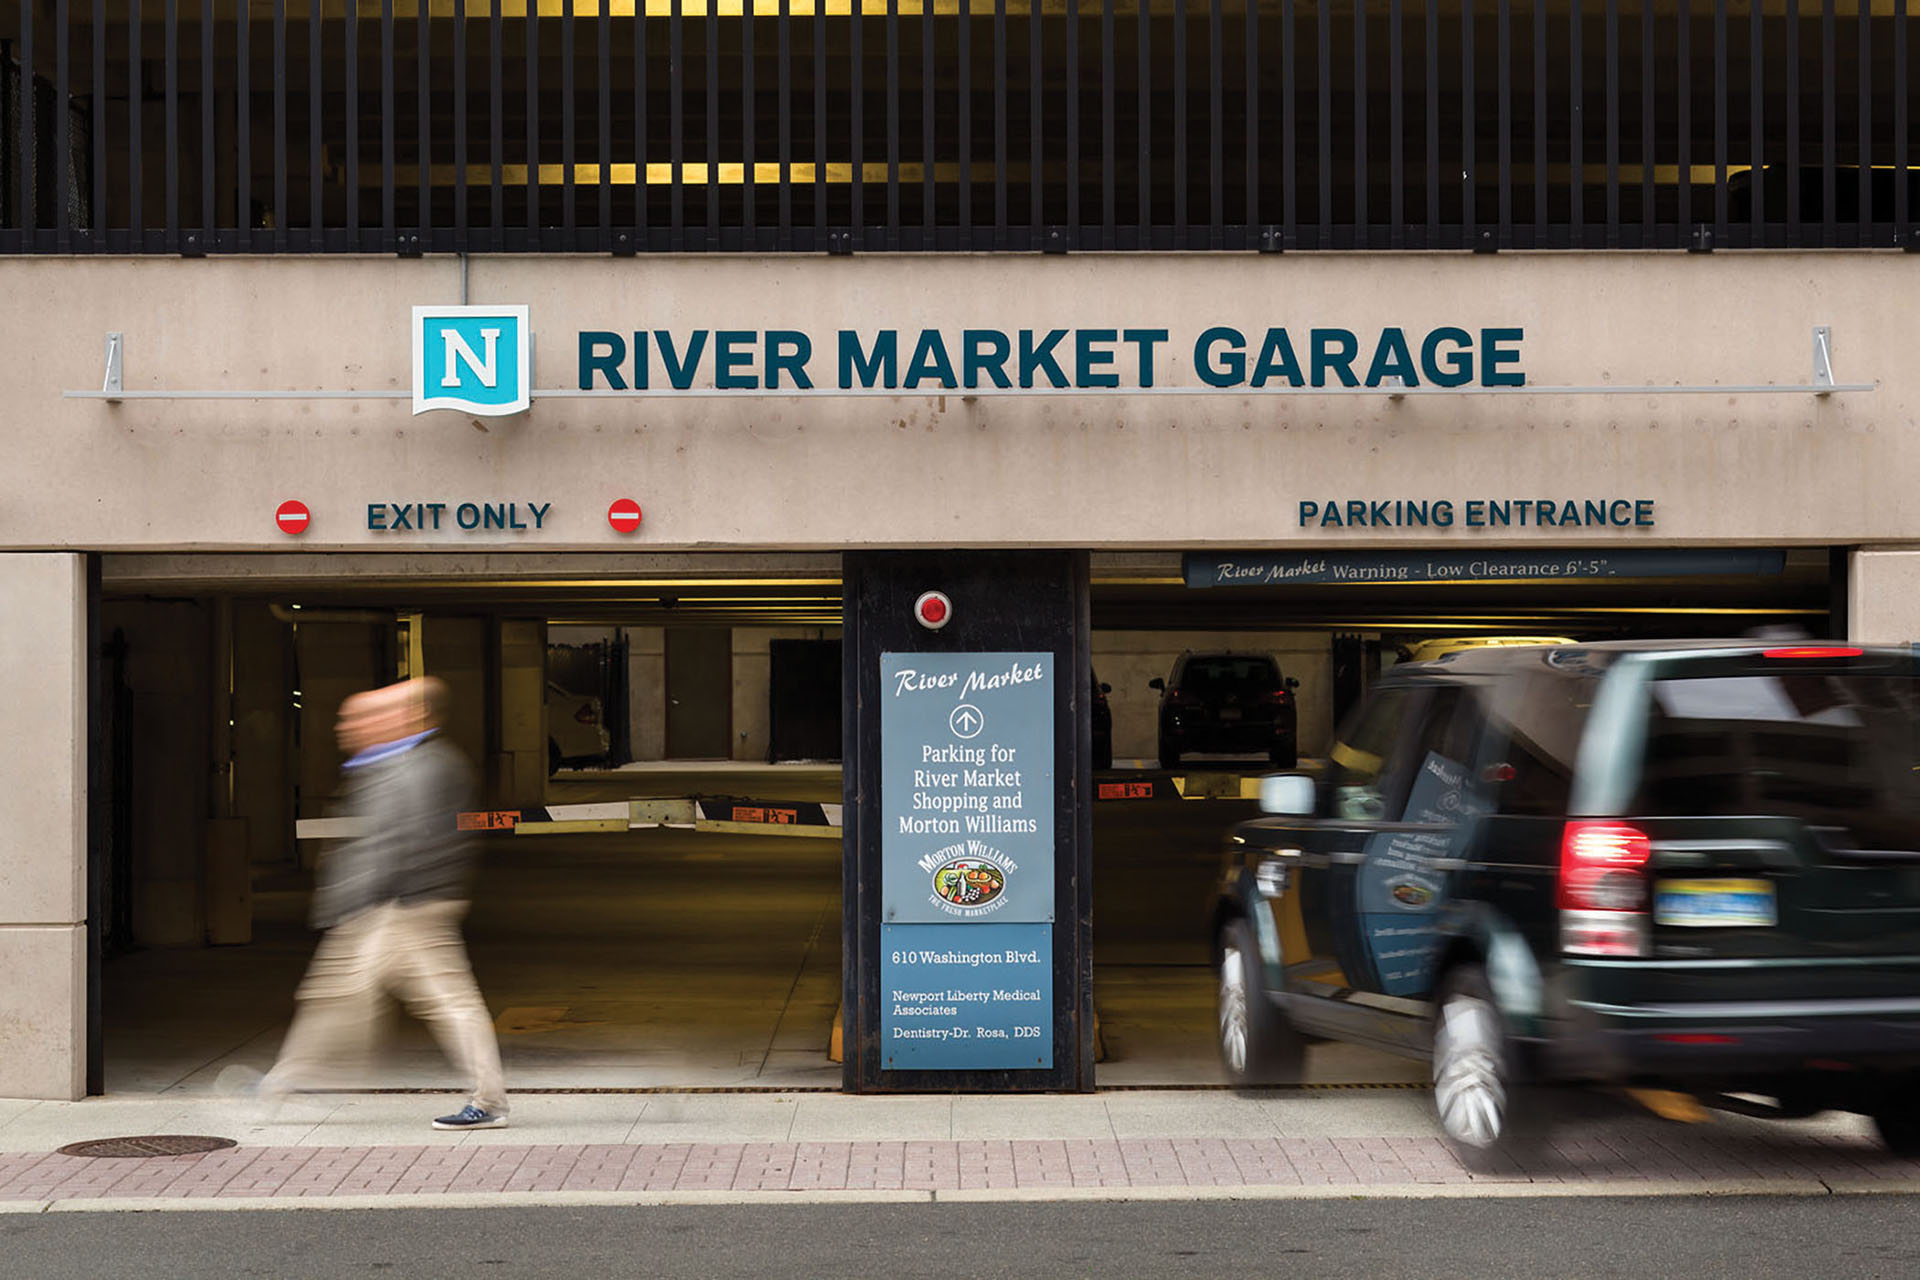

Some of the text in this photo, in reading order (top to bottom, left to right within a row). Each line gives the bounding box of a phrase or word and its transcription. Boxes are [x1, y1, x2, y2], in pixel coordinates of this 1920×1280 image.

[440, 328, 500, 388] N
[578, 326, 1526, 390] RIVER MARKET GARAGE
[366, 502, 551, 531] EXIT ONLY
[1298, 500, 1656, 528] PARKING ENTRANCE
[1217, 563, 1264, 582] River
[1264, 560, 1326, 583] Market
[1332, 565, 1409, 580] Warning
[1426, 563, 1464, 577] Low
[1469, 561, 1561, 576] Clearance
[894, 662, 1044, 700] River Market
[921, 743, 1017, 767] Parking for
[913, 769, 1022, 788] River Market
[912, 791, 1023, 813] Shopping and
[898, 815, 1038, 834] Morton Williams
[917, 839, 1019, 875] MORTON WILLIAMS
[891, 950, 1041, 967] 610 Washington Blvd.
[891, 989, 1041, 1004] Newport Liberty Medical
[892, 1004, 958, 1017] Associates
[892, 1026, 1041, 1041] Dentistry-Dr. Rosa, DDS
